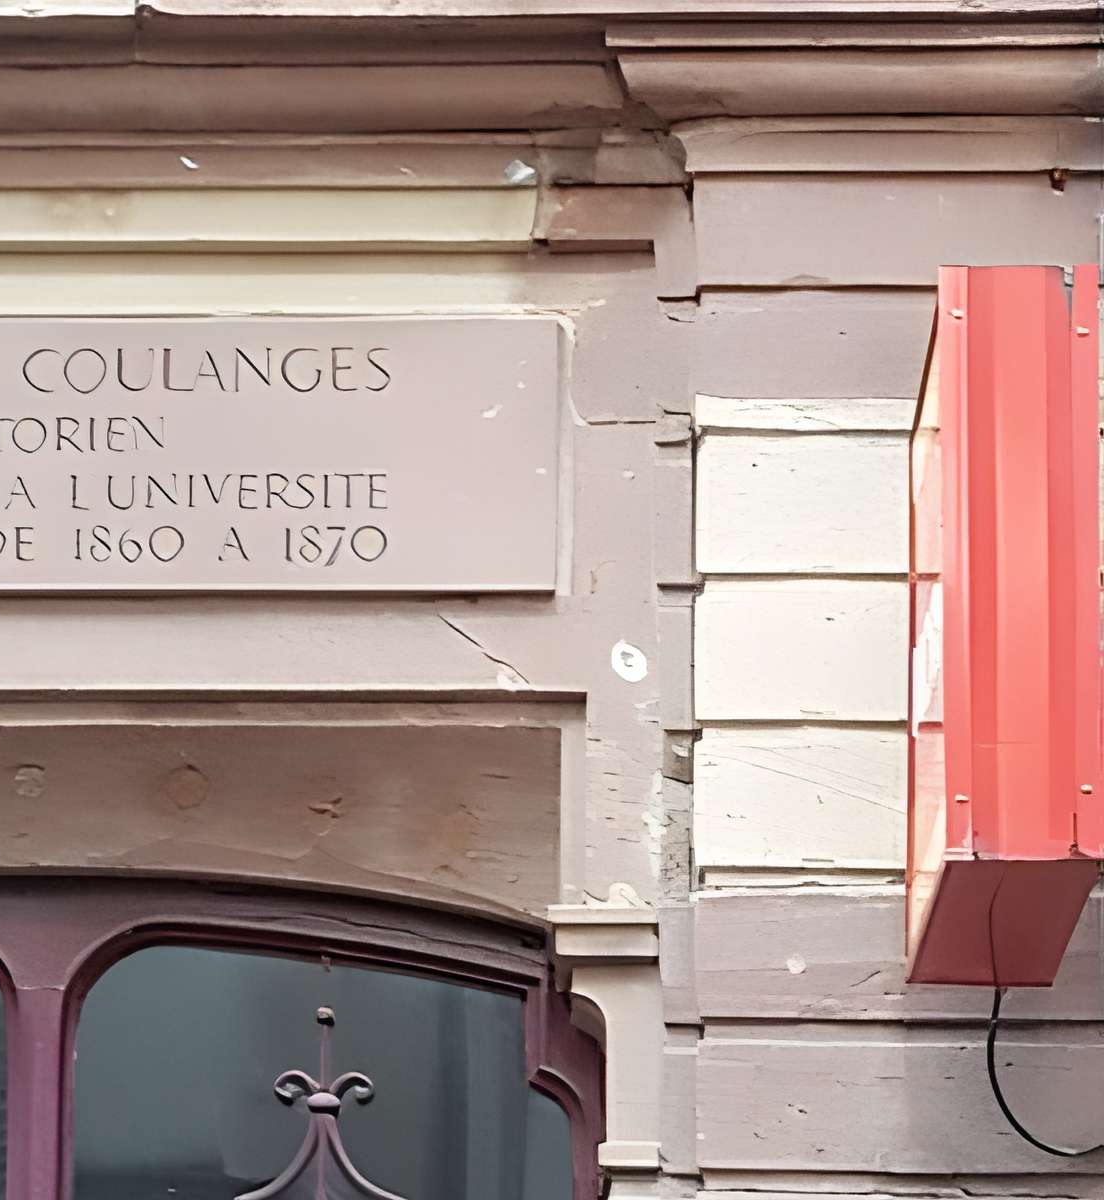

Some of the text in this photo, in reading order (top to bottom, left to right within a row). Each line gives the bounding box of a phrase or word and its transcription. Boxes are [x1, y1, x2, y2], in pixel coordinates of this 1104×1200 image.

[22, 347, 391, 394] COULANGES
[4, 474, 37, 511] A
[74, 524, 185, 564] 1860
[216, 526, 251, 563] A
[284, 524, 388, 568] 1870
